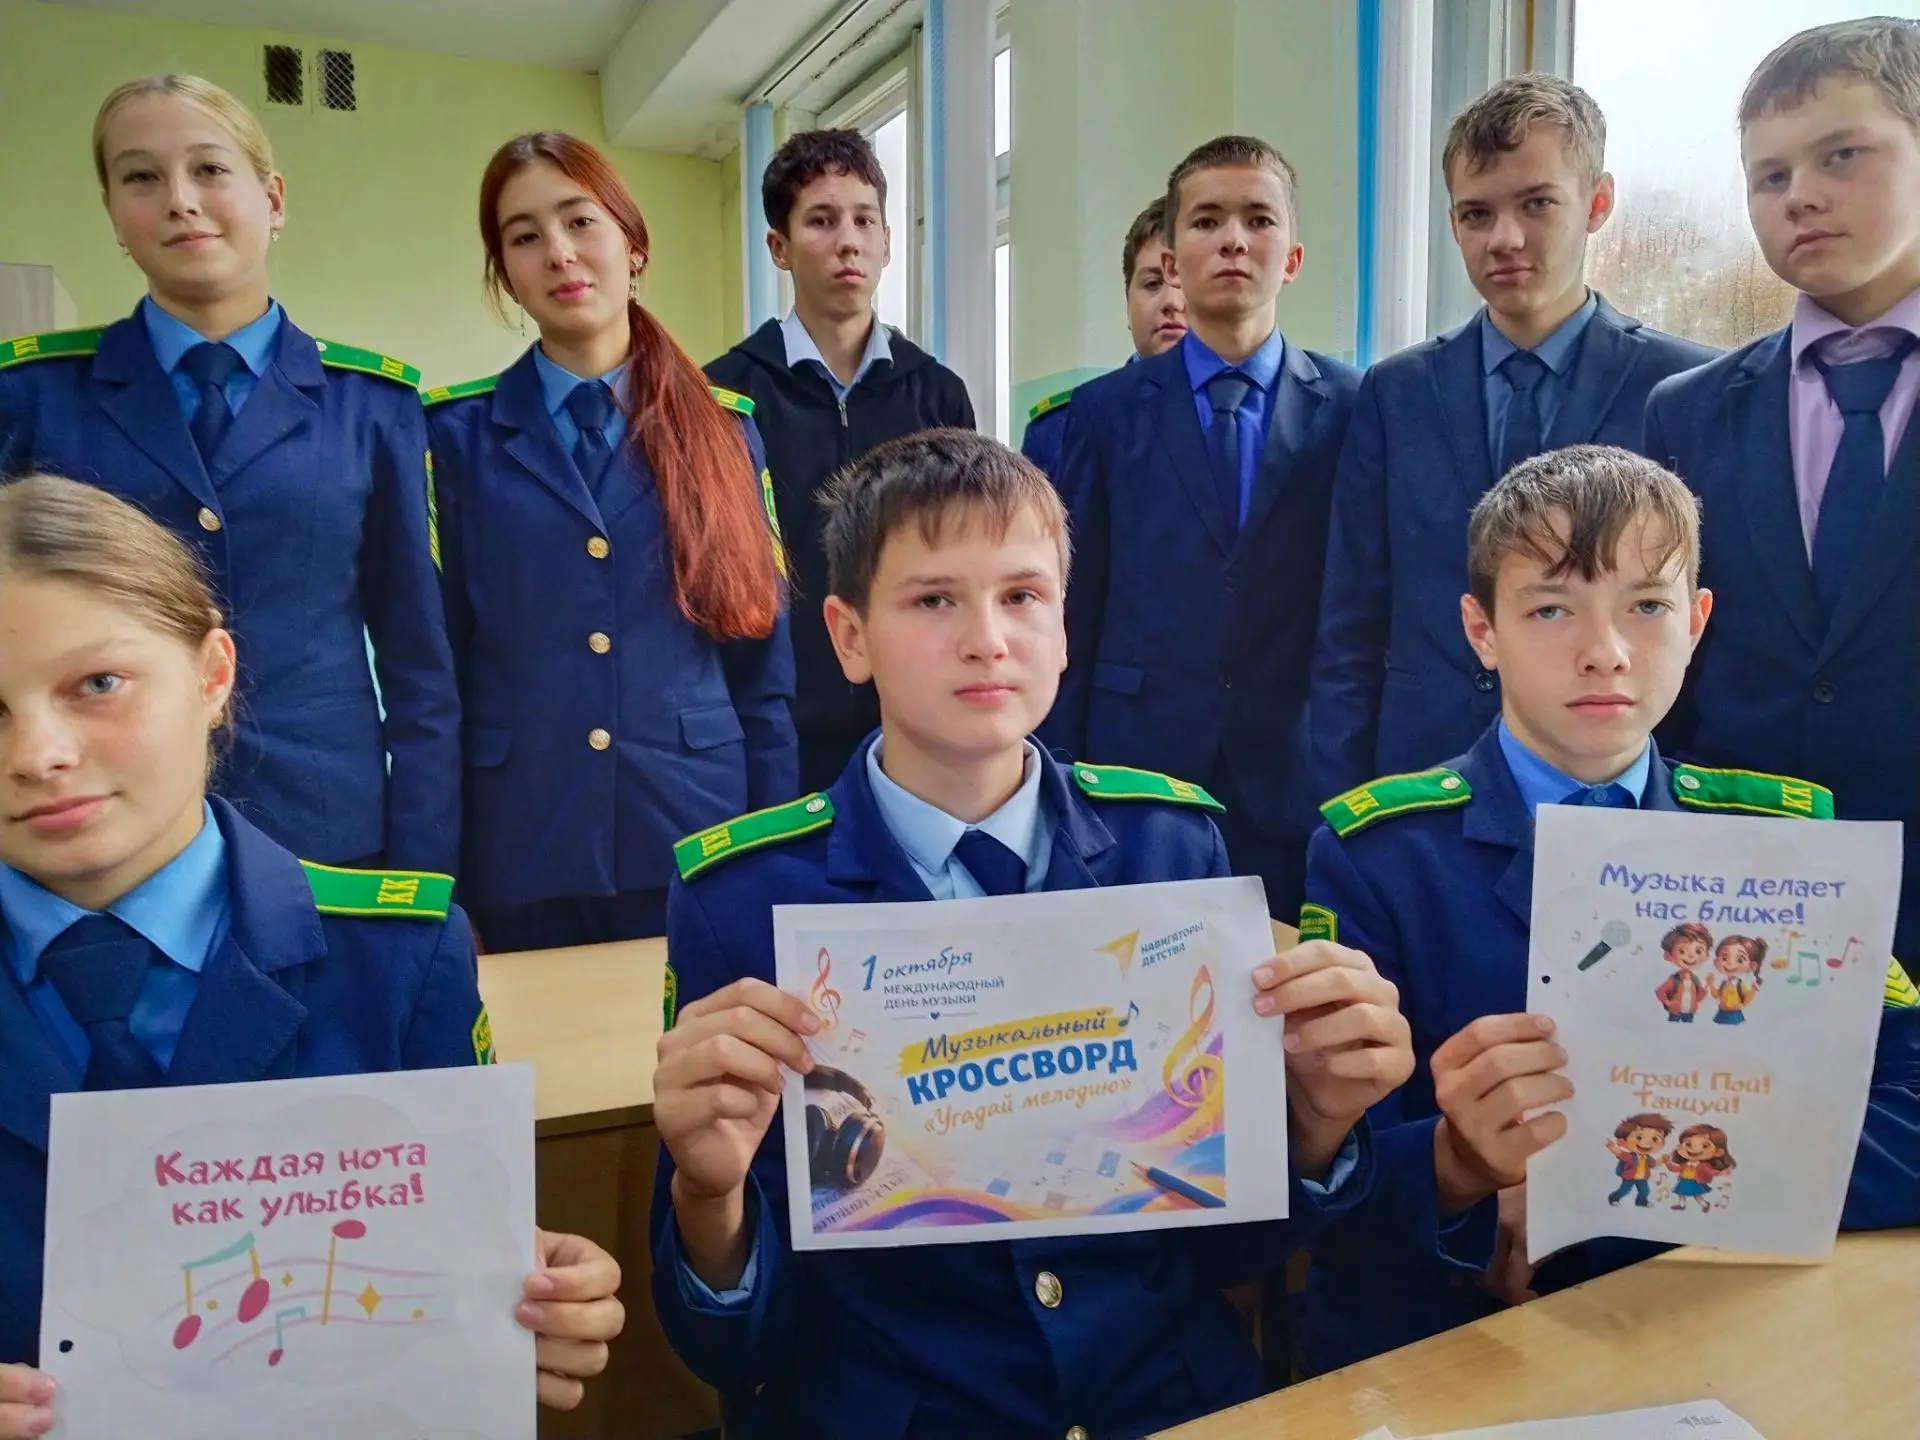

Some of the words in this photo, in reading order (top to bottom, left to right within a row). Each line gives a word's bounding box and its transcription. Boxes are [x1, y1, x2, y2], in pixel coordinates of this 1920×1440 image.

[1600, 862, 1724, 895] Музыка
[1736, 874, 1846, 899] делает
[1635, 900, 1688, 921] нас
[1698, 899, 1806, 926] ближе!
[1140, 921, 1205, 955] НАВИГАТОРЫ
[1141, 942, 1187, 969] ДЕТСТВА
[860, 954, 878, 992] 1
[883, 946, 974, 980] октября
[883, 975, 1005, 996] МЕЖДУНАРОДНЫЙ
[883, 994, 919, 1011] ДЕНЬ
[921, 993, 977, 1008] МУЗЫКИ
[921, 1007, 1107, 1065] Музыкальный
[906, 1038, 1138, 1106] КРОССВОРД
[1609, 1063, 1700, 1091] Играй!
[1710, 1071, 1773, 1094] Пой!
[923, 1097, 1014, 1136] «Угадай
[1020, 1076, 1133, 1110] мелодию»
[1633, 1090, 1741, 1116] Танцуй!
[154, 1150, 325, 1188] Каждая
[338, 1142, 427, 1172] нота
[171, 1195, 244, 1226] как
[258, 1172, 425, 1227] улыбка!
